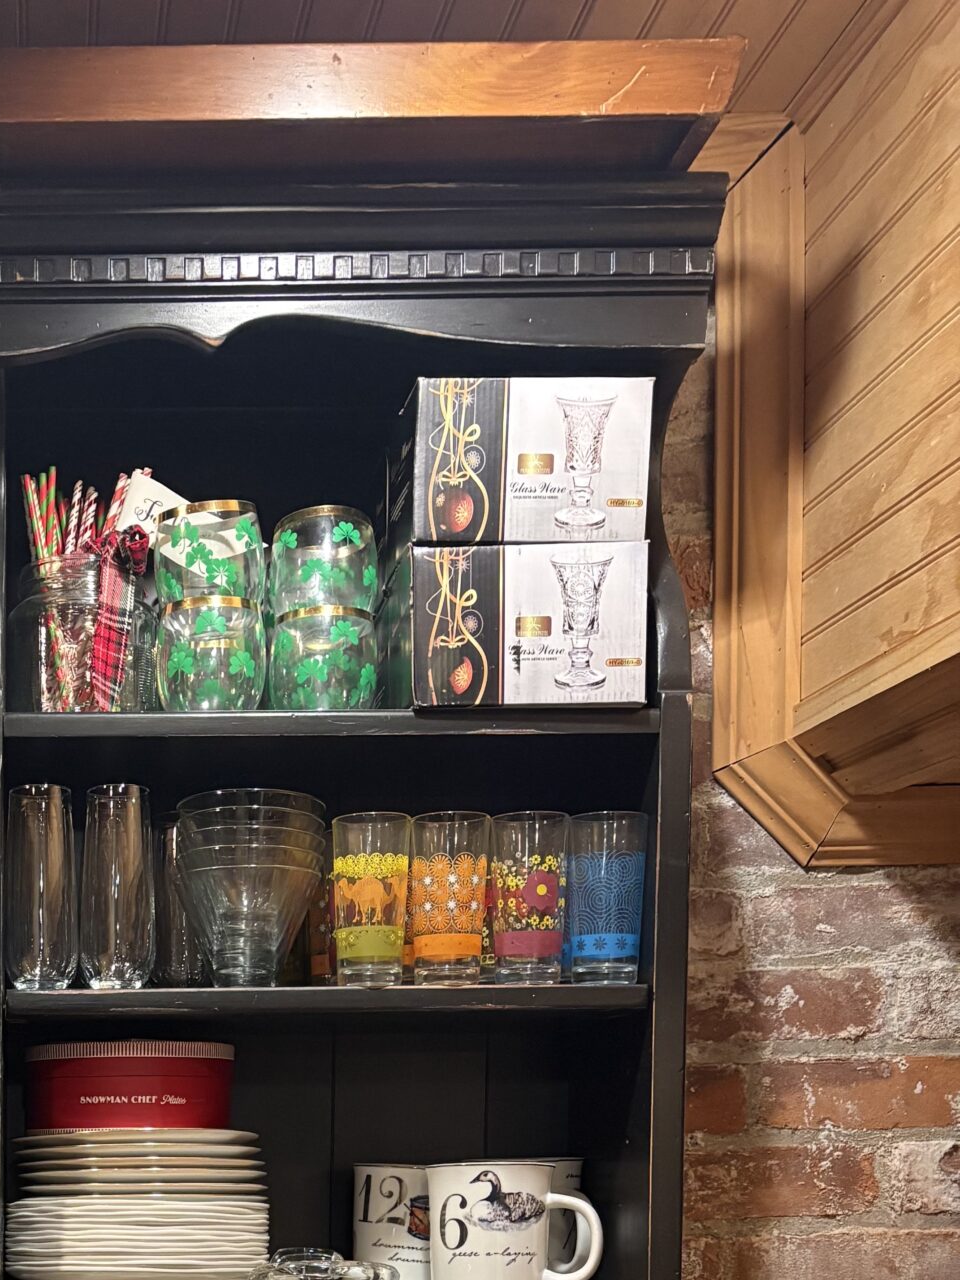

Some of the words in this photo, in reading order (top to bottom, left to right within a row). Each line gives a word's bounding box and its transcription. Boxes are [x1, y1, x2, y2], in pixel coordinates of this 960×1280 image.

[509, 481, 537, 494] Glass
[539, 481, 567, 494] Ware
[537, 643, 566, 655] Ware
[80, 1095, 129, 1104] SNOWMAN
[131, 1095, 158, 1104] CHEF
[160, 1094, 187, 1105] Plates
[358, 1173, 408, 1226] 12
[439, 1193, 469, 1250] 6
[448, 1251, 480, 1264] geese
